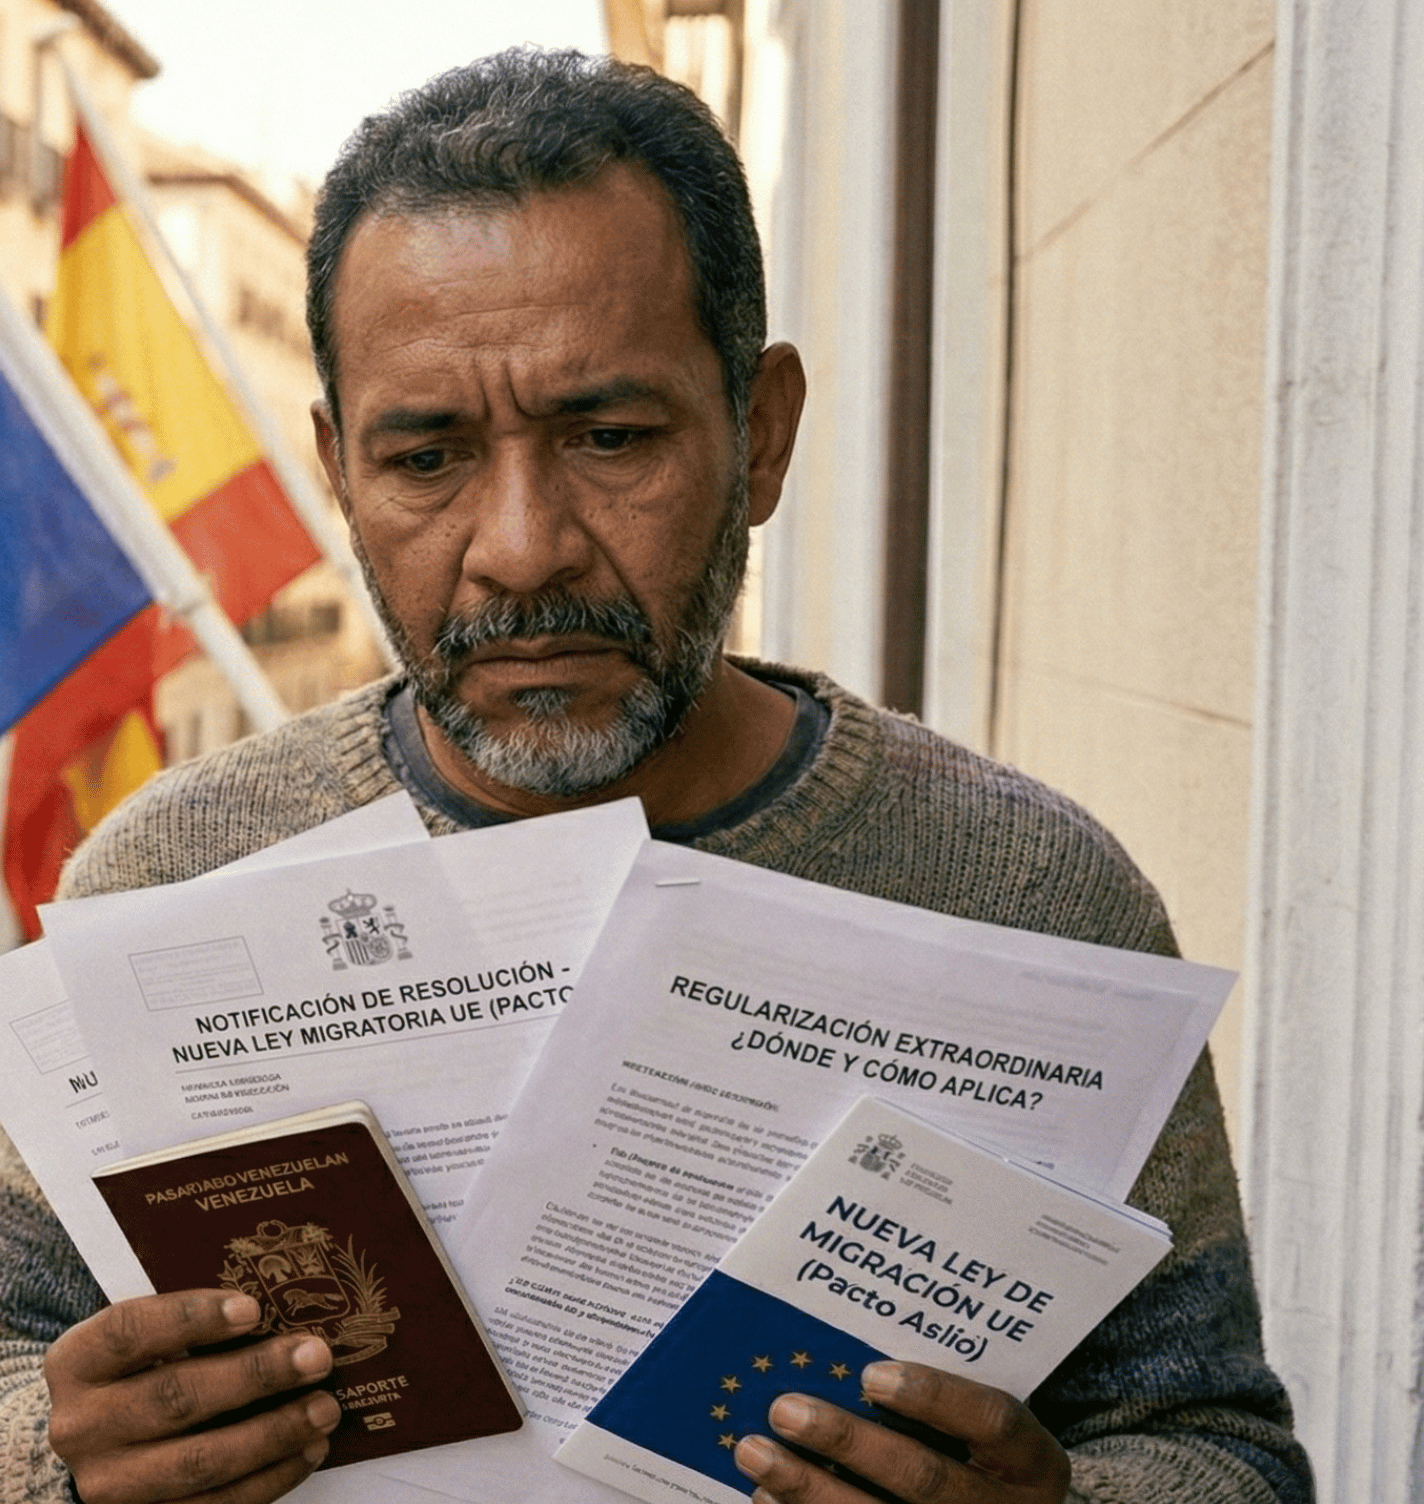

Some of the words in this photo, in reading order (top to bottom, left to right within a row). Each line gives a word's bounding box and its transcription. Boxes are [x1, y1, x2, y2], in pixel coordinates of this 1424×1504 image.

[195, 992, 356, 1034] NOTIFICACIÓN
[361, 988, 395, 1009] DE
[399, 959, 554, 1004] RESOLUCIÓN
[172, 1037, 249, 1064] NUEVA
[251, 1029, 294, 1052] LEY
[299, 1008, 446, 1046] MIGRATORIA
[449, 1001, 484, 1022] UE
[669, 975, 891, 1048] REGULARIZACIÓN
[894, 1032, 1104, 1090] EXTRAORDINARIA
[730, 1029, 837, 1069] ¿DÓNDE
[843, 1052, 860, 1073] Y
[862, 1058, 937, 1091] CÓMO
[939, 1076, 1043, 1111] APLICA?
[194, 1176, 315, 1212] VENEZUELA
[236, 1151, 350, 1185] VENEZUELAN
[796, 1258, 897, 1317] (Pacto
[799, 1220, 985, 1321] MIGRACIÓN
[986, 1309, 1035, 1343] UE
[825, 1195, 937, 1264] NUEVA
[941, 1251, 1008, 1289] LEY
[1003, 1280, 1055, 1315] DE
[336, 1374, 410, 1401] SAPORTE
